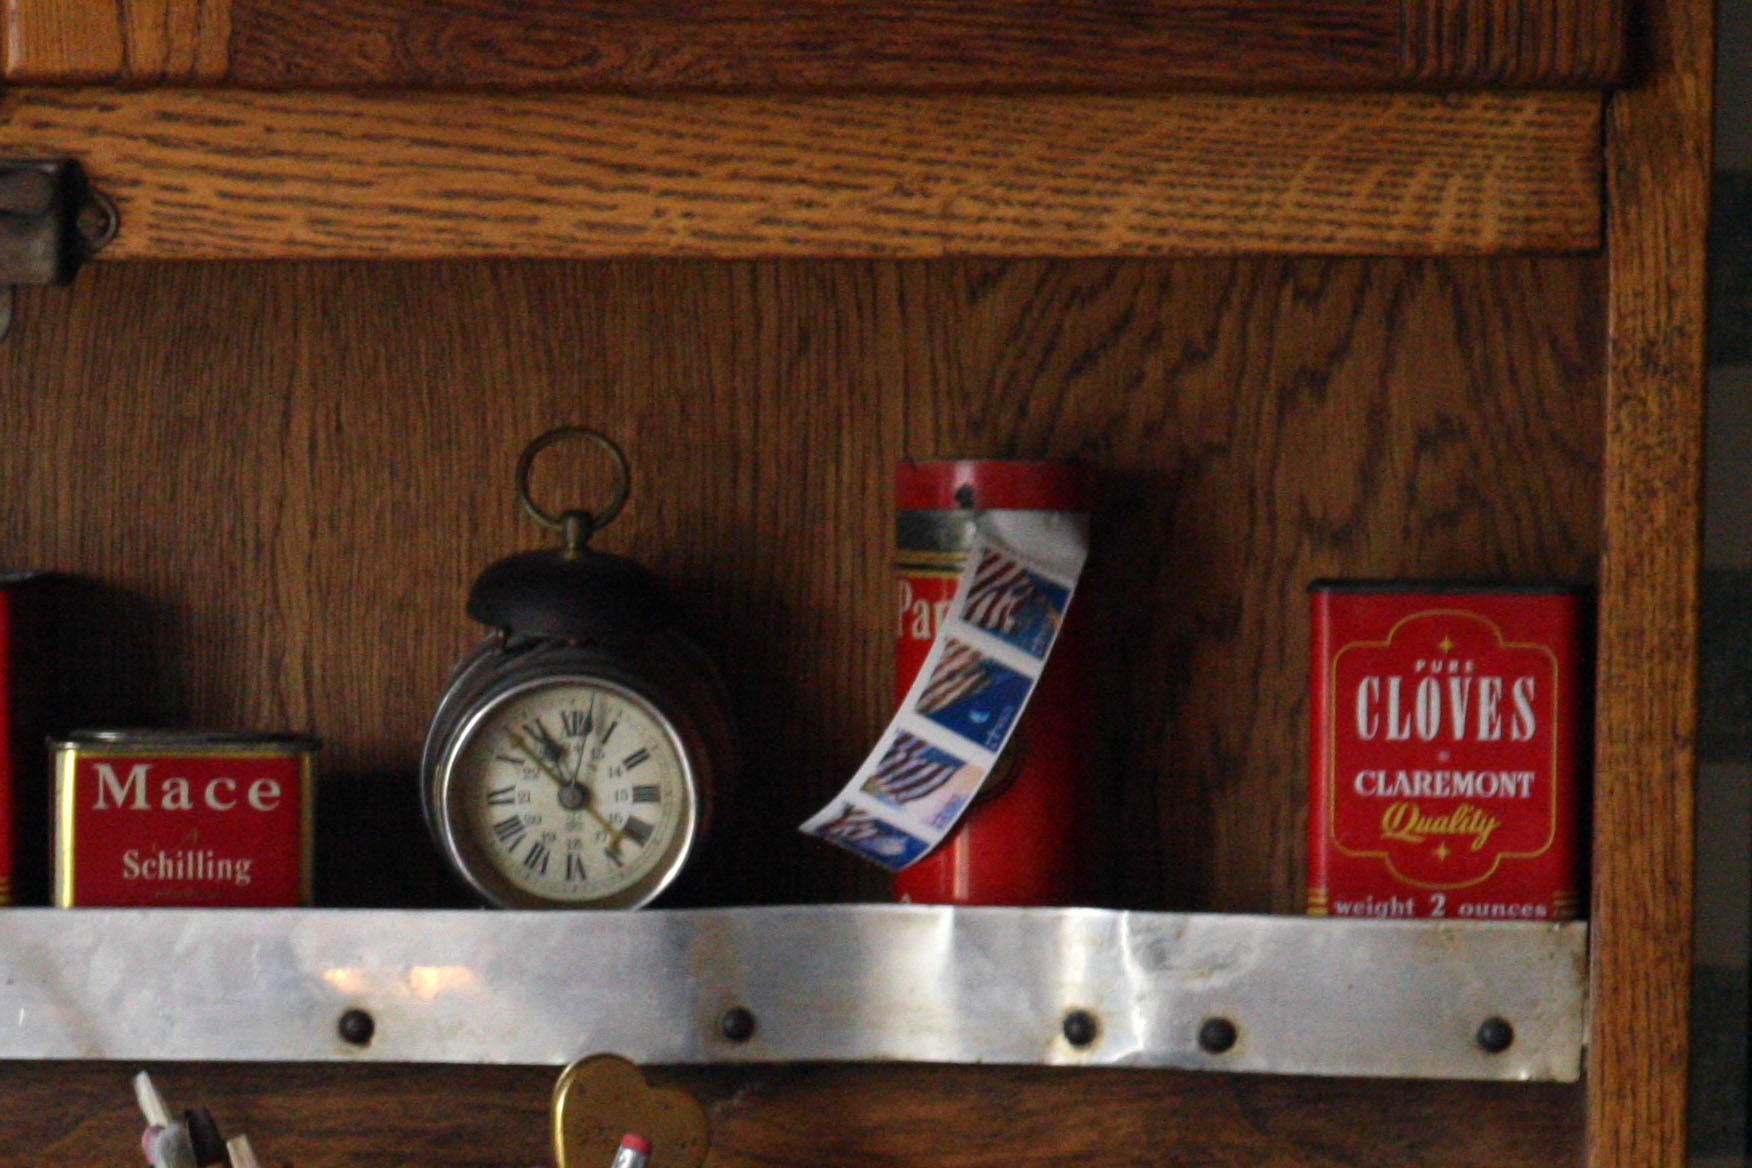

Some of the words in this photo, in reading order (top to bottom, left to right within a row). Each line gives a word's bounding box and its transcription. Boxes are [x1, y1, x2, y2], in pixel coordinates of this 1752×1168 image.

[1414, 658, 1476, 674] PURE
[1355, 675, 1537, 742] CLOVES
[91, 761, 282, 811] Mace
[1353, 769, 1537, 798] CLAREMONT
[1380, 801, 1501, 851] Quality
[122, 848, 253, 886] Schilling
[1430, 892, 1447, 918] 2
[1458, 900, 1548, 918] ounces
